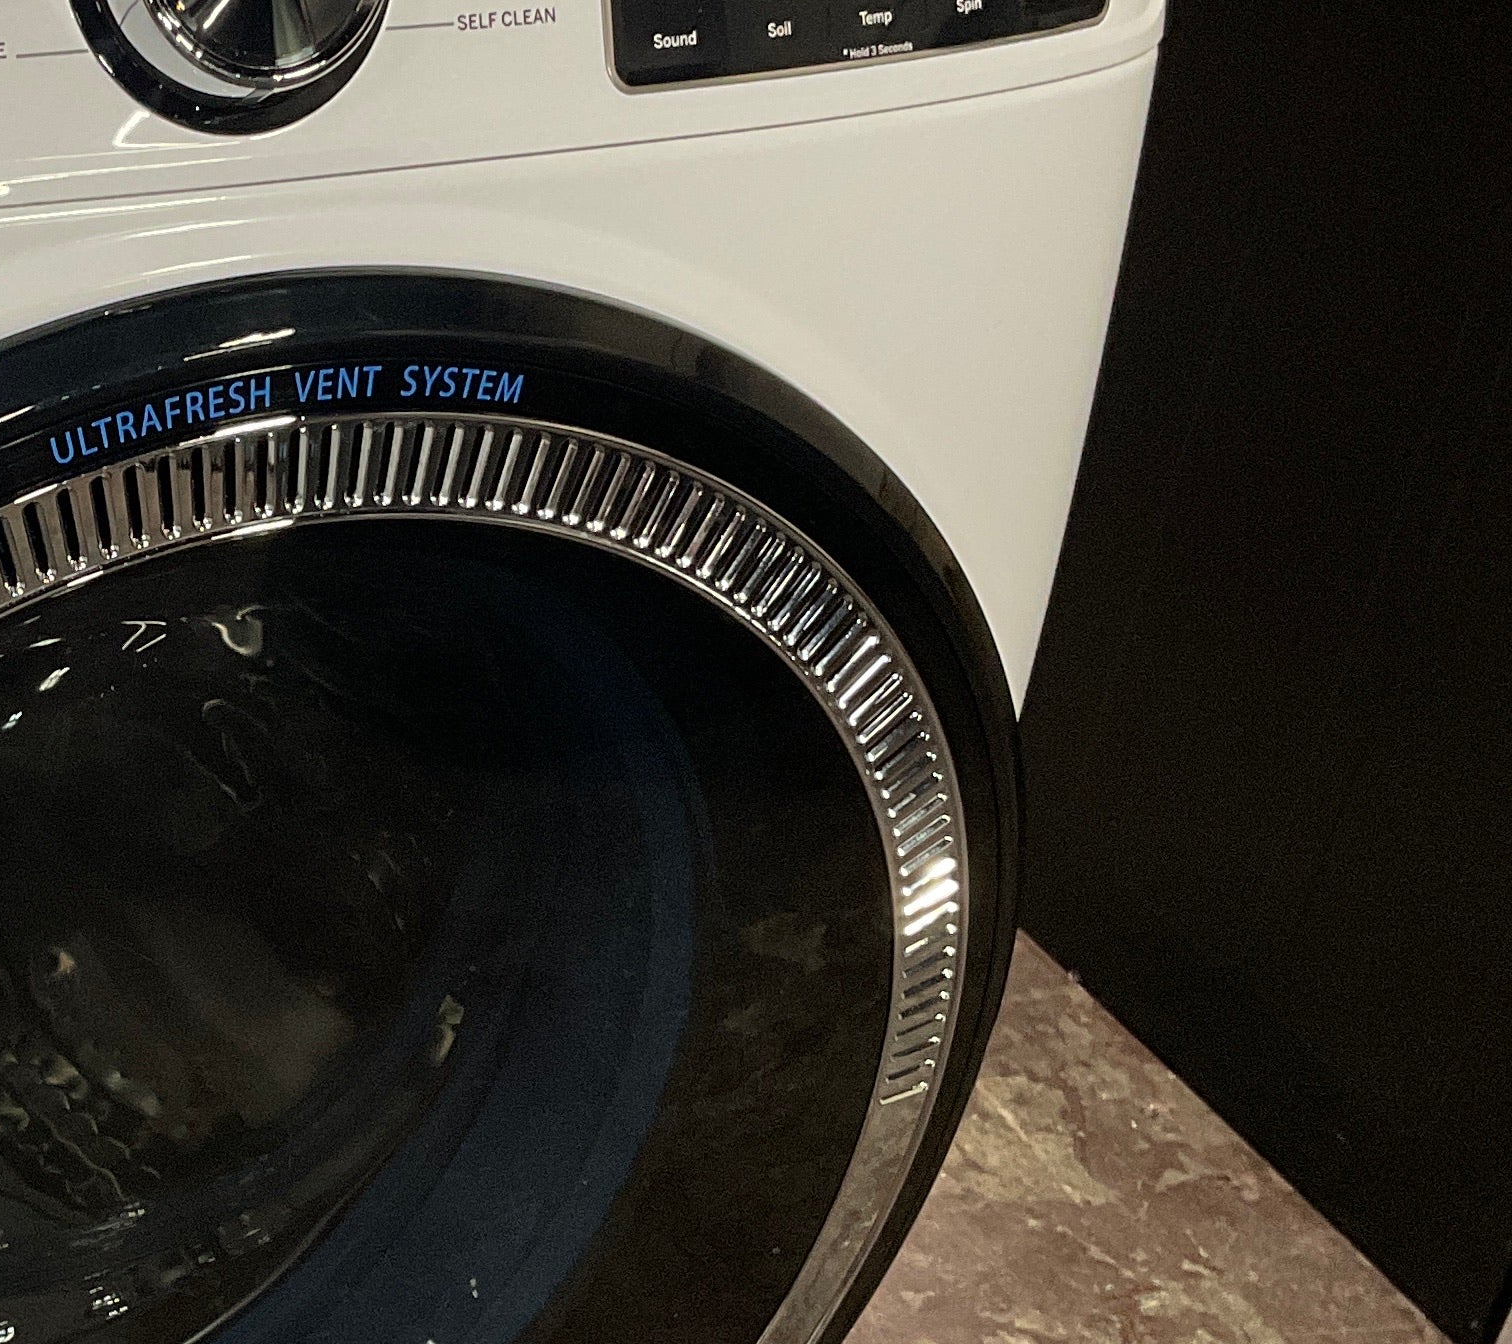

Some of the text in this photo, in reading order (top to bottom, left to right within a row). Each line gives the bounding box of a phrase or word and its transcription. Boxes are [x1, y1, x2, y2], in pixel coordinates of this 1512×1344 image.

[457, 7, 557, 31] SELF CLEAN
[859, 9, 893, 27] Temp
[653, 29, 698, 50] Sound
[767, 21, 792, 38] Soil
[849, 46, 869, 59] Hold
[878, 40, 913, 56] Seconds
[50, 364, 525, 465] ULTRAFRESH VENT SYSTEM
